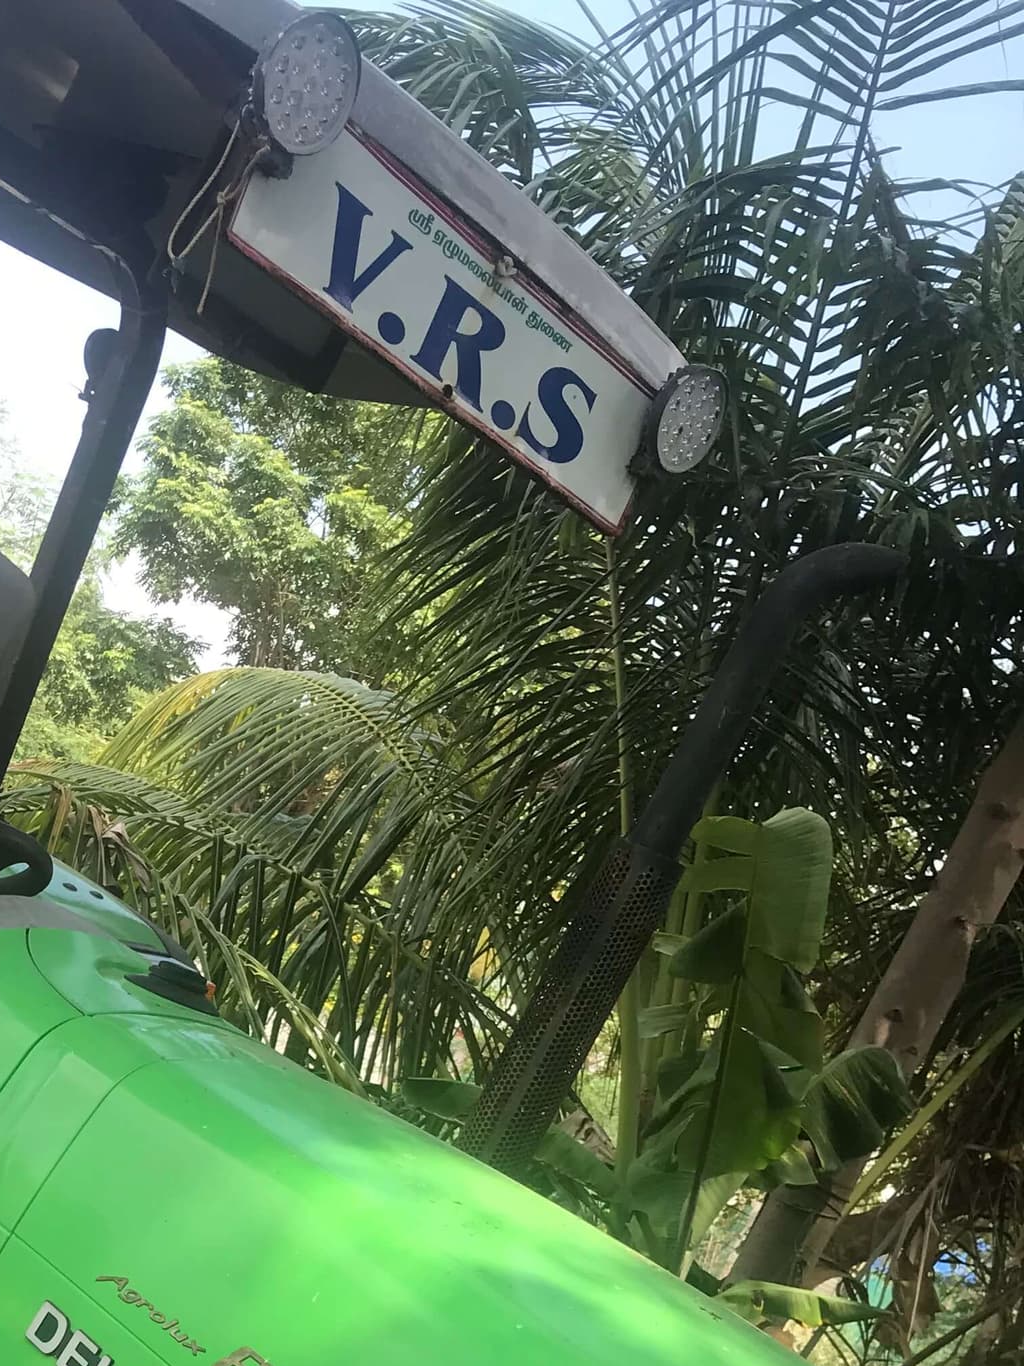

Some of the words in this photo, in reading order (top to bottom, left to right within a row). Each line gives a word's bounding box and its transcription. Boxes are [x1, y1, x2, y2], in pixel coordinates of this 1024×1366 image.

[322, 181, 597, 464] V.R.S
[525, 311, 573, 353] துணை
[96, 1275, 206, 1356] Agrolux
